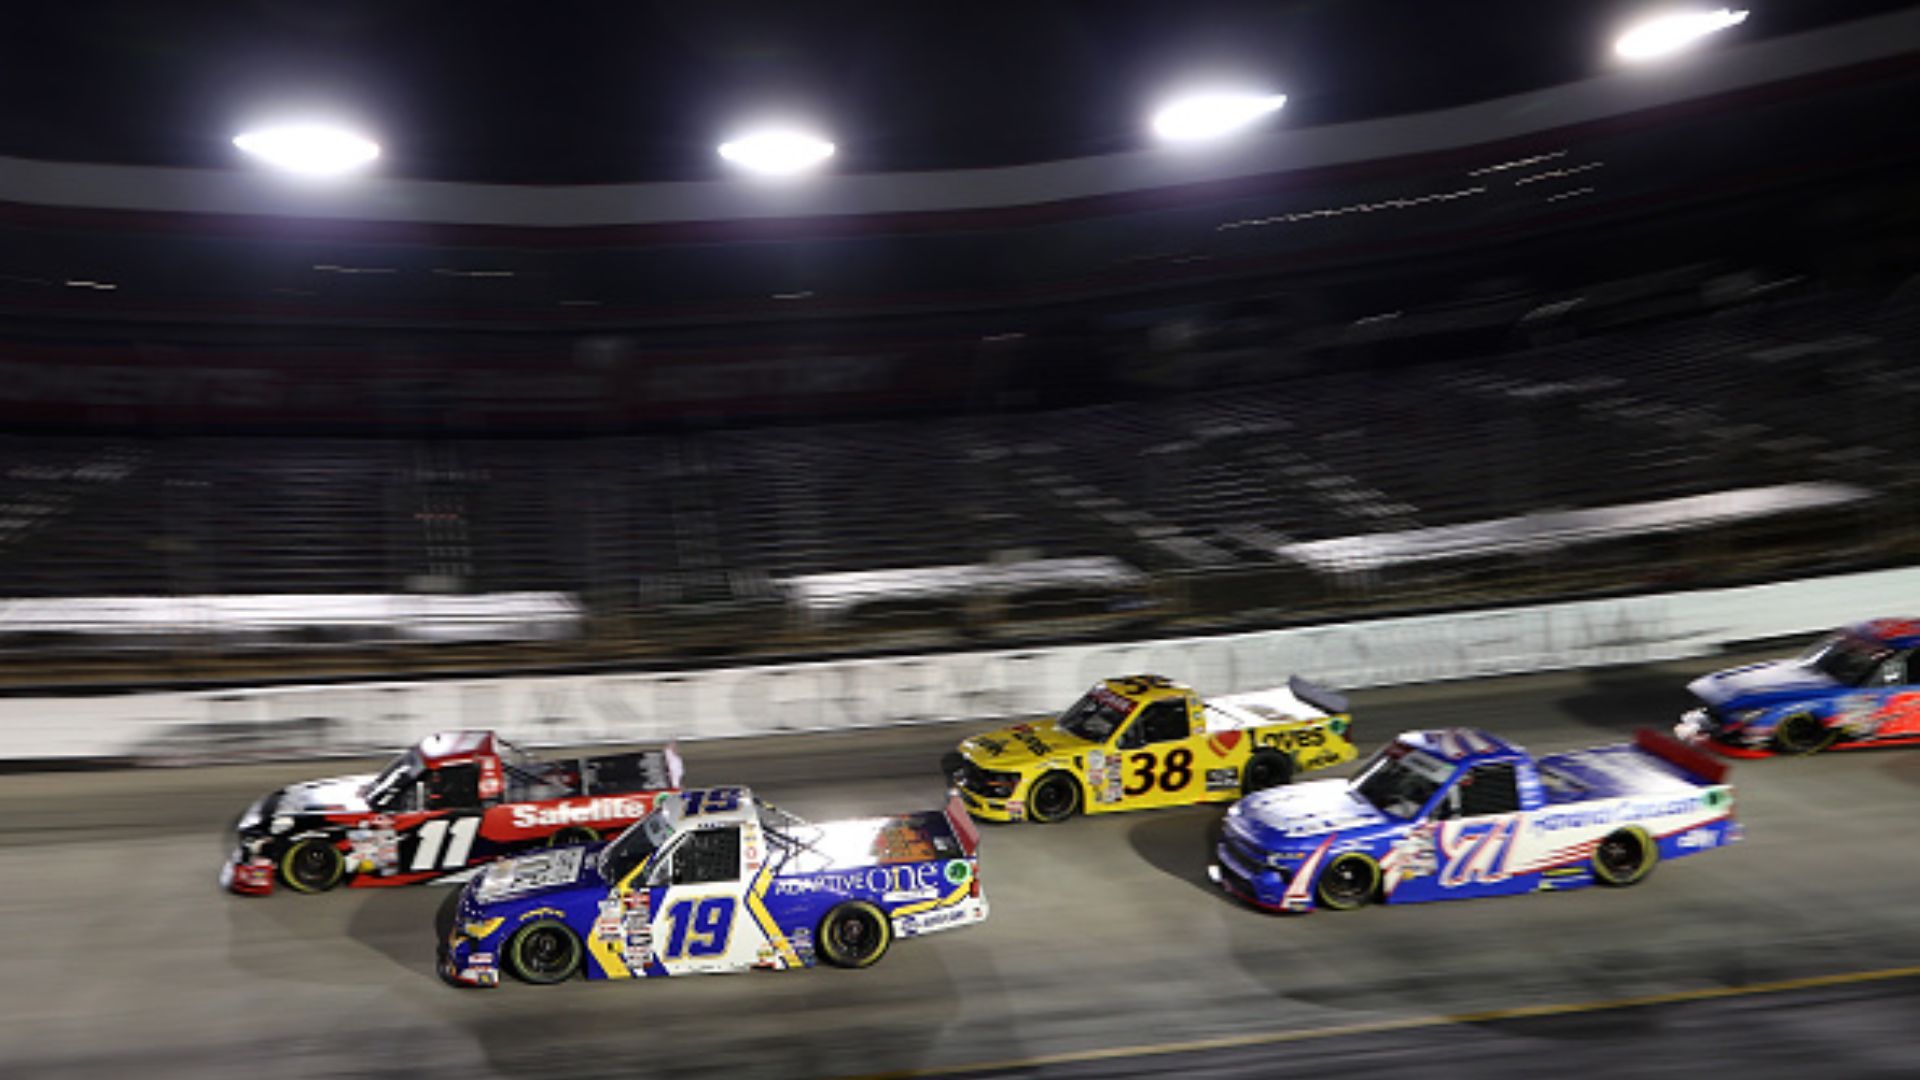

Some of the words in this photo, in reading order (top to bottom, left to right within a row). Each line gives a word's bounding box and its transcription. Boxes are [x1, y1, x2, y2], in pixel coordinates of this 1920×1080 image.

[1123, 748, 1194, 796] 38
[512, 797, 646, 828] Safelite
[409, 815, 483, 871] 11
[662, 895, 738, 962] 19
